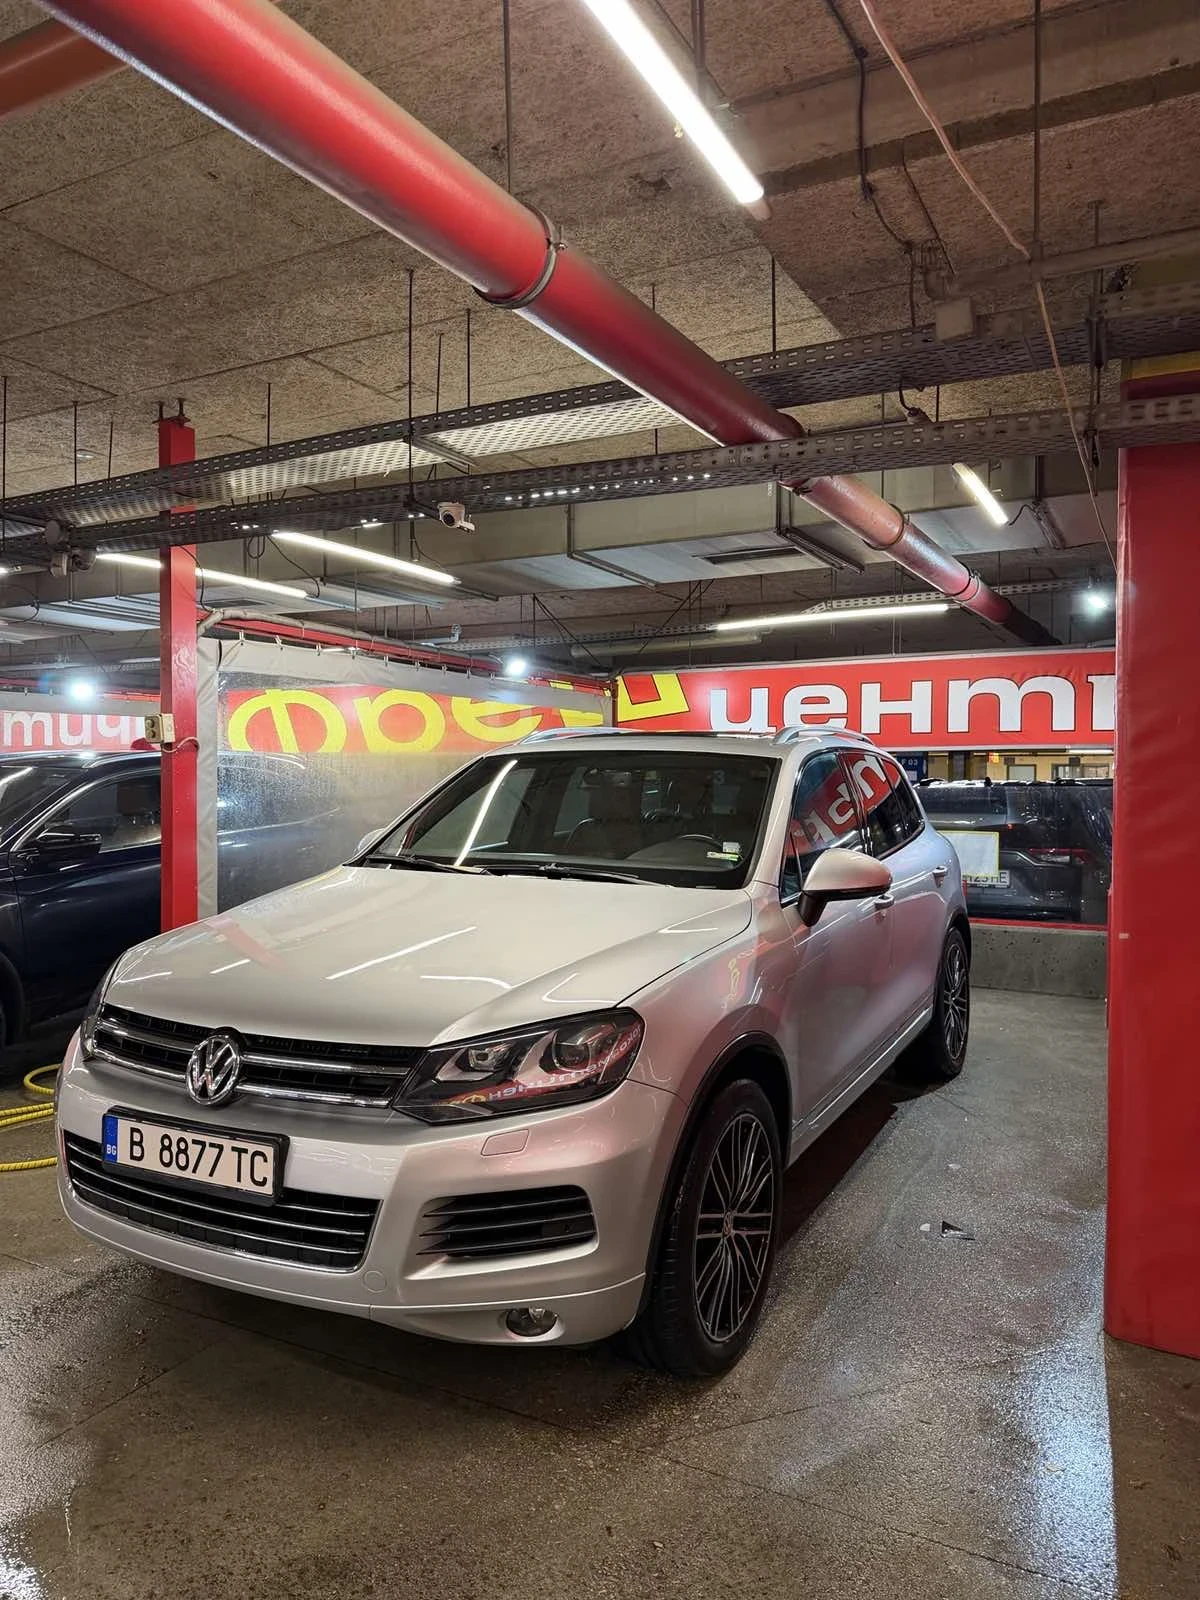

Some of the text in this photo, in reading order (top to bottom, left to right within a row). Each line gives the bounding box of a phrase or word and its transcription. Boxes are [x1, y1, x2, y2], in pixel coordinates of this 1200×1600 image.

[106, 1144, 117, 1156] BG
[129, 1127, 268, 1187] B 8877 TC
